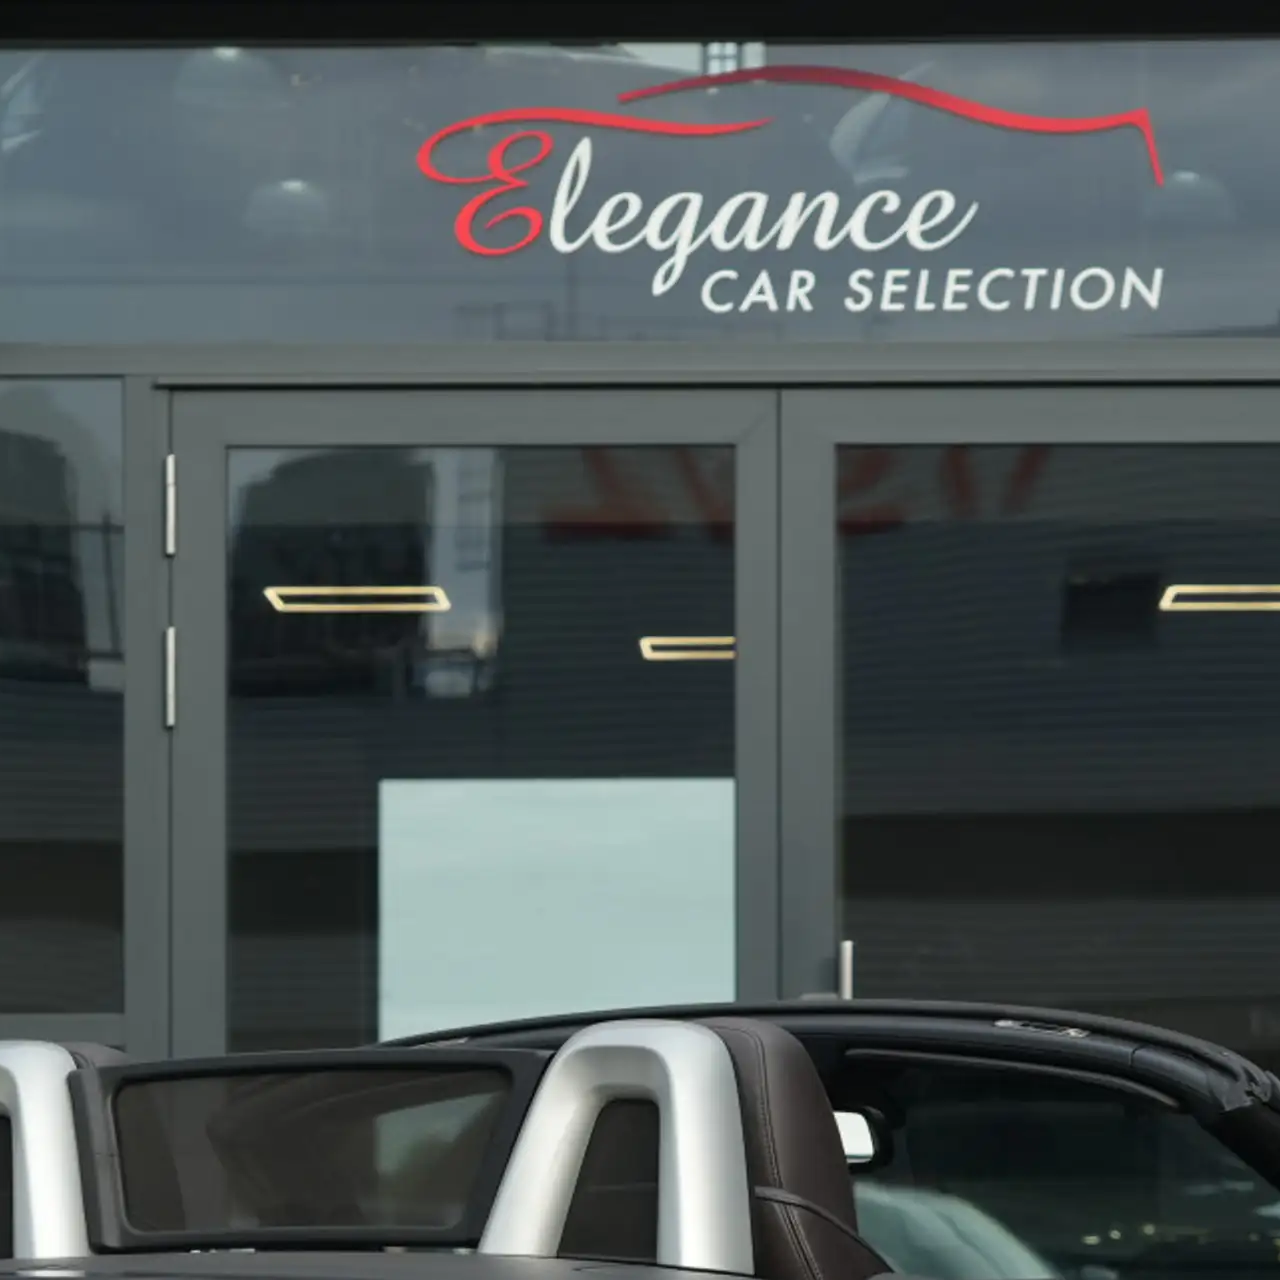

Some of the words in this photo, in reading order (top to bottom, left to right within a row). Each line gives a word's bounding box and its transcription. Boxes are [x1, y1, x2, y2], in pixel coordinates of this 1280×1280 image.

[416, 107, 979, 297] Elegance
[701, 270, 815, 312] CAR
[844, 267, 1165, 312] SELECTION
